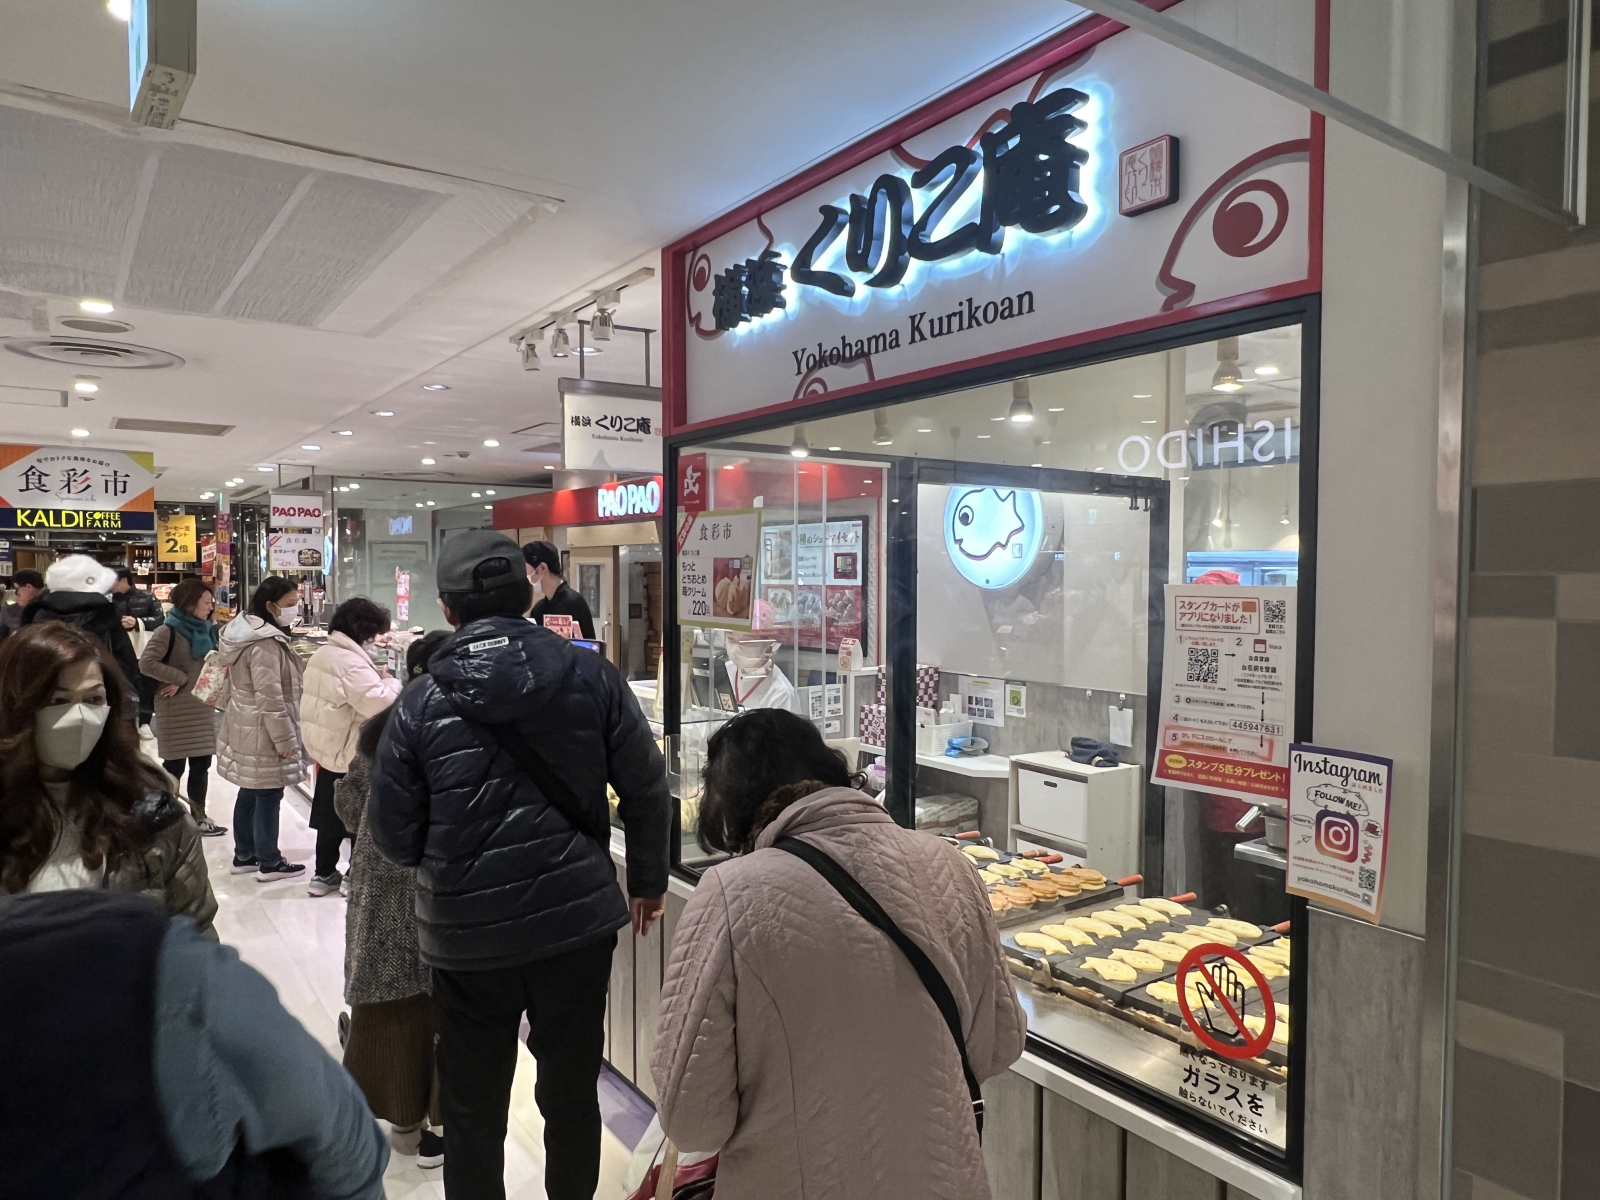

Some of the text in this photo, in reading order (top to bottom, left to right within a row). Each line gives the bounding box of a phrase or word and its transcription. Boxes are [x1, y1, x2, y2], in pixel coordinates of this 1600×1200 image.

[791, 87, 1089, 297] くりこ庵
[791, 290, 1036, 376] Yokohama Kurikoan
[571, 415, 592, 427] 横浜
[595, 414, 652, 435] くりこ庵
[17, 465, 131, 496] 食彩市
[598, 481, 661, 518] PAOPAO
[17, 509, 121, 527] KALDI COFFEE
[86, 519, 121, 528] FARM
[699, 522, 732, 541] 食彩市
[165, 538, 189, 553] 2倍
[682, 561, 696, 571] もっと
[682, 574, 707, 585] とちおとめ
[682, 586, 707, 597] 苺クリーム
[692, 600, 706, 616] 220
[1179, 600, 1241, 612] スタンプカードが
[1179, 612, 1252, 624] アプリになりました!
[1232, 721, 1280, 734] 445947631
[1294, 753, 1383, 787] Instagram
[1314, 790, 1362, 812] FOLLOW ME!
[1182, 1064, 1265, 1117] ガラスを
[1178, 1085, 1268, 1135] 触らないでください
